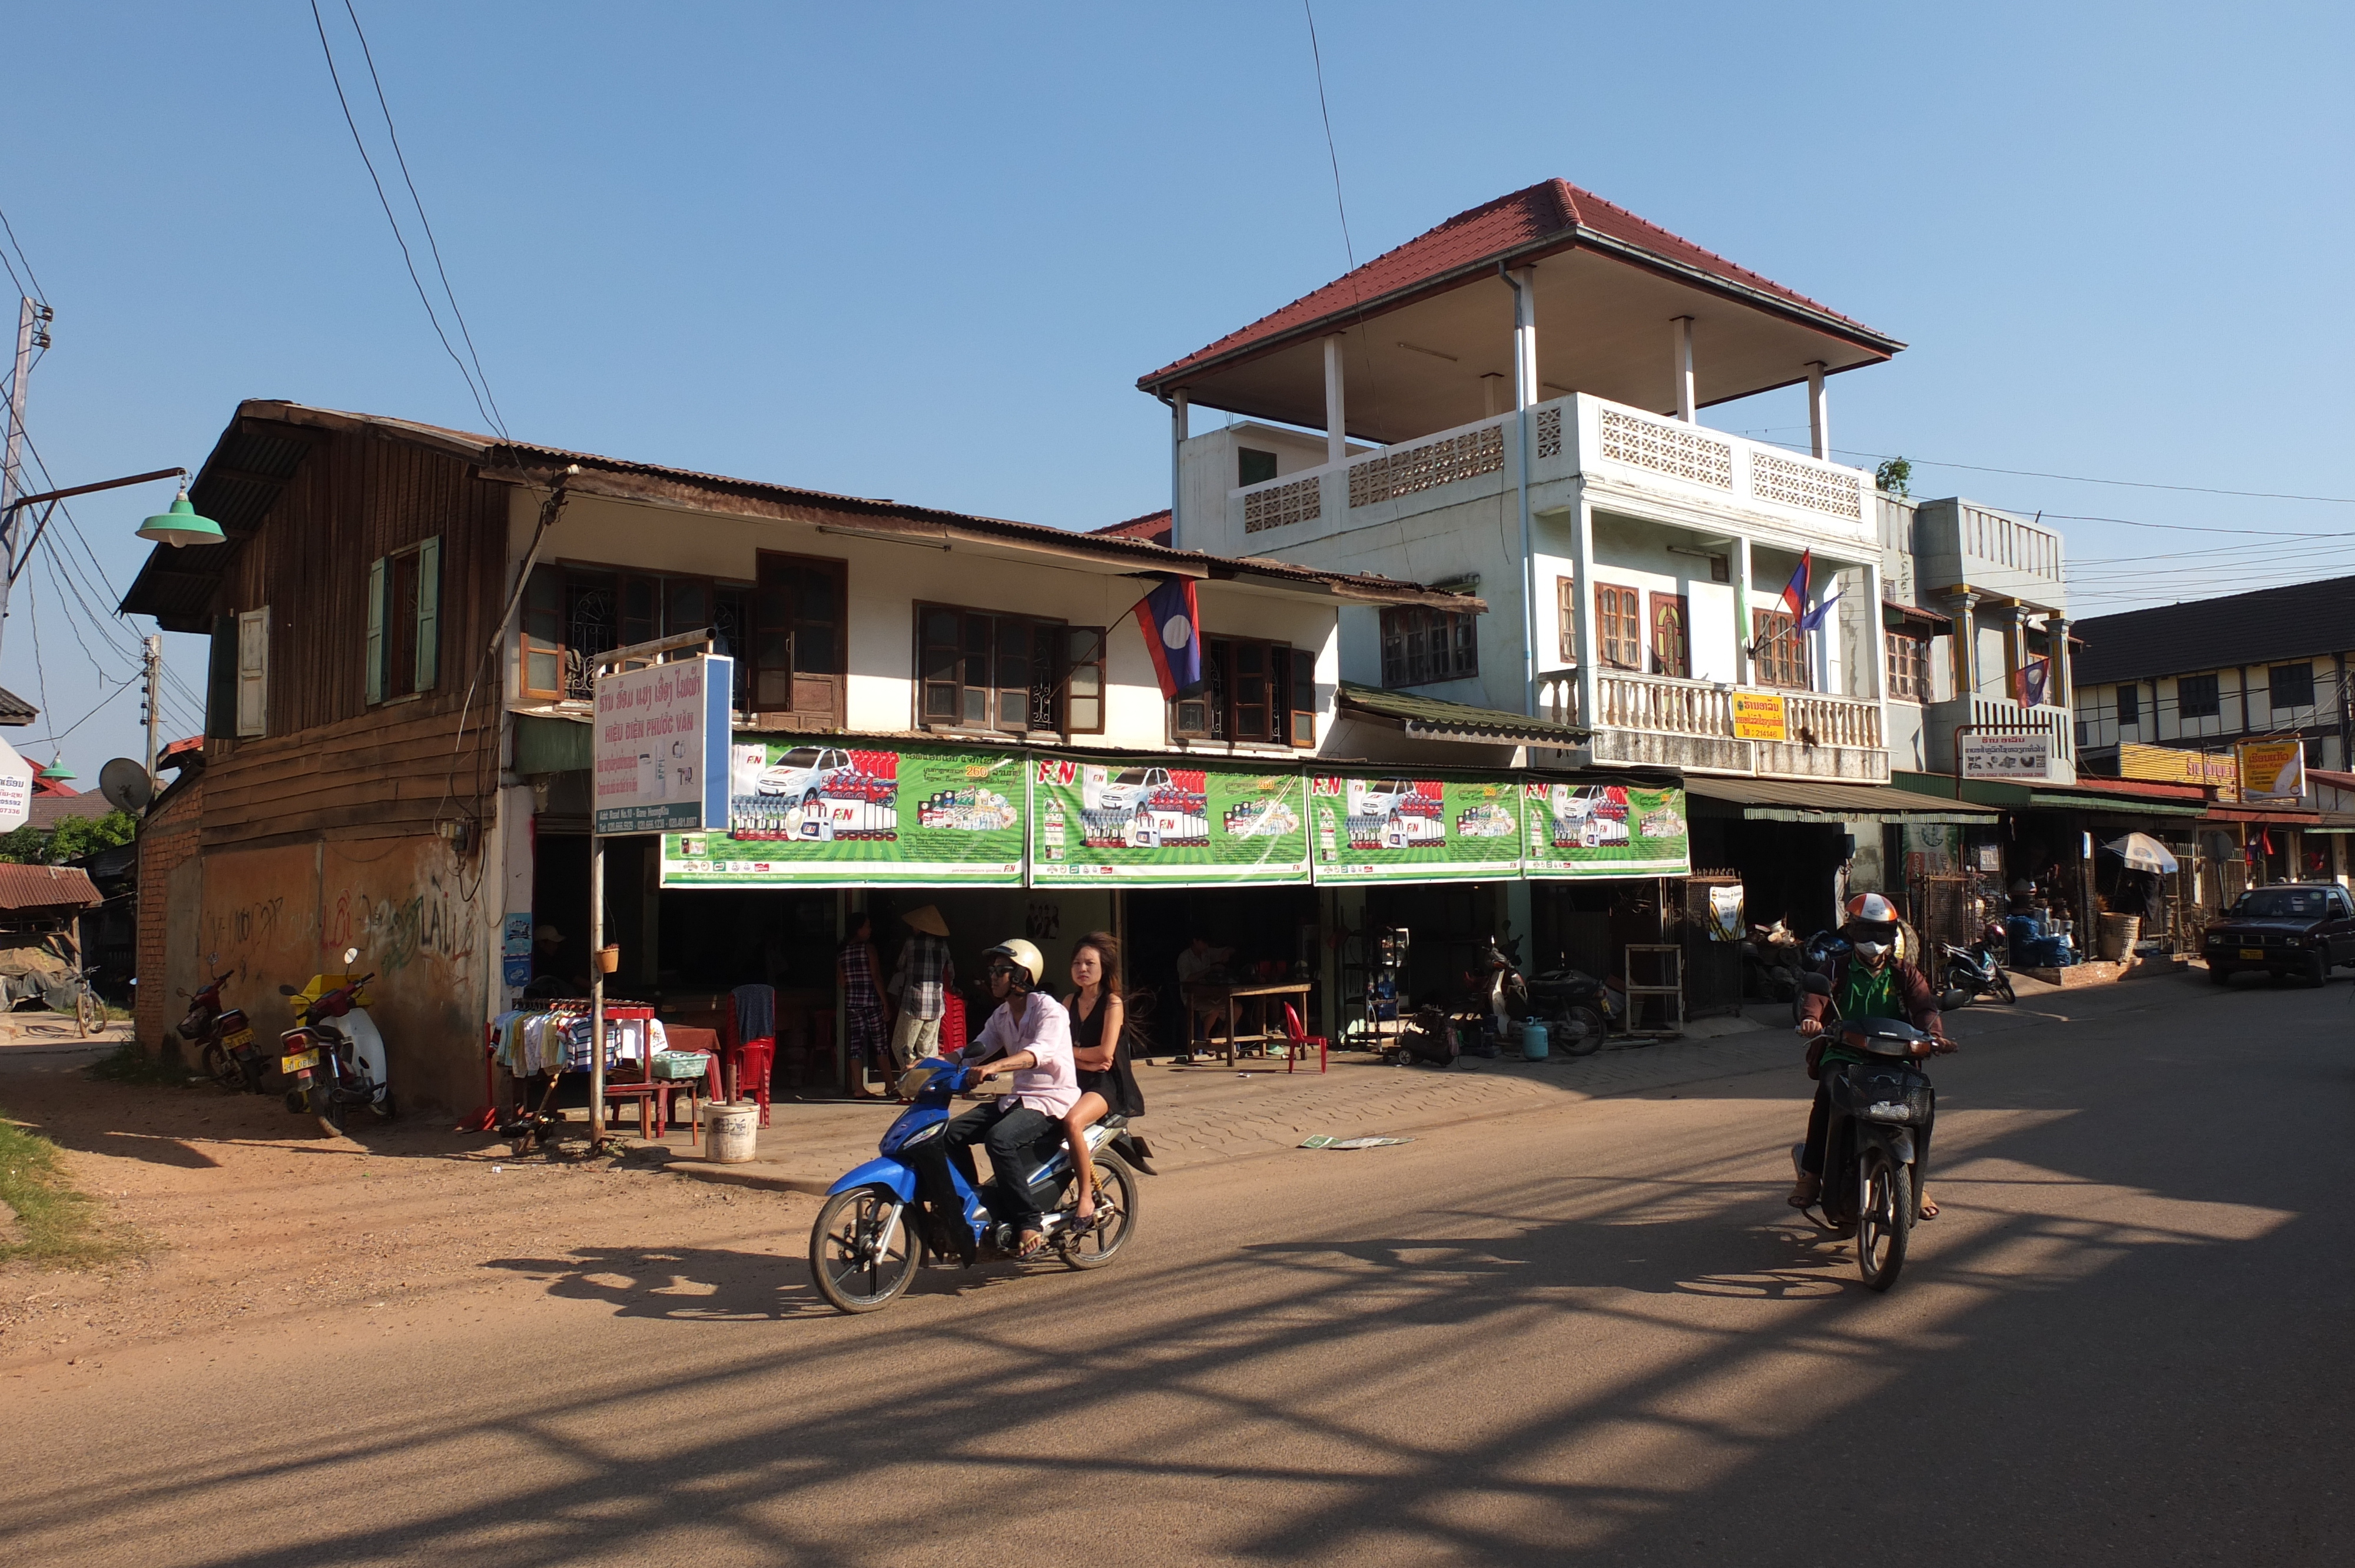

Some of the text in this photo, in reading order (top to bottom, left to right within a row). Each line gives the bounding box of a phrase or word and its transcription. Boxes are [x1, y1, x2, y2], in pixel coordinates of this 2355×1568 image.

[966, 766, 988, 777] 260
[1039, 759, 1076, 785] F&N
[832, 808, 853, 820] F&N
[1159, 819, 1174, 829] F&N
